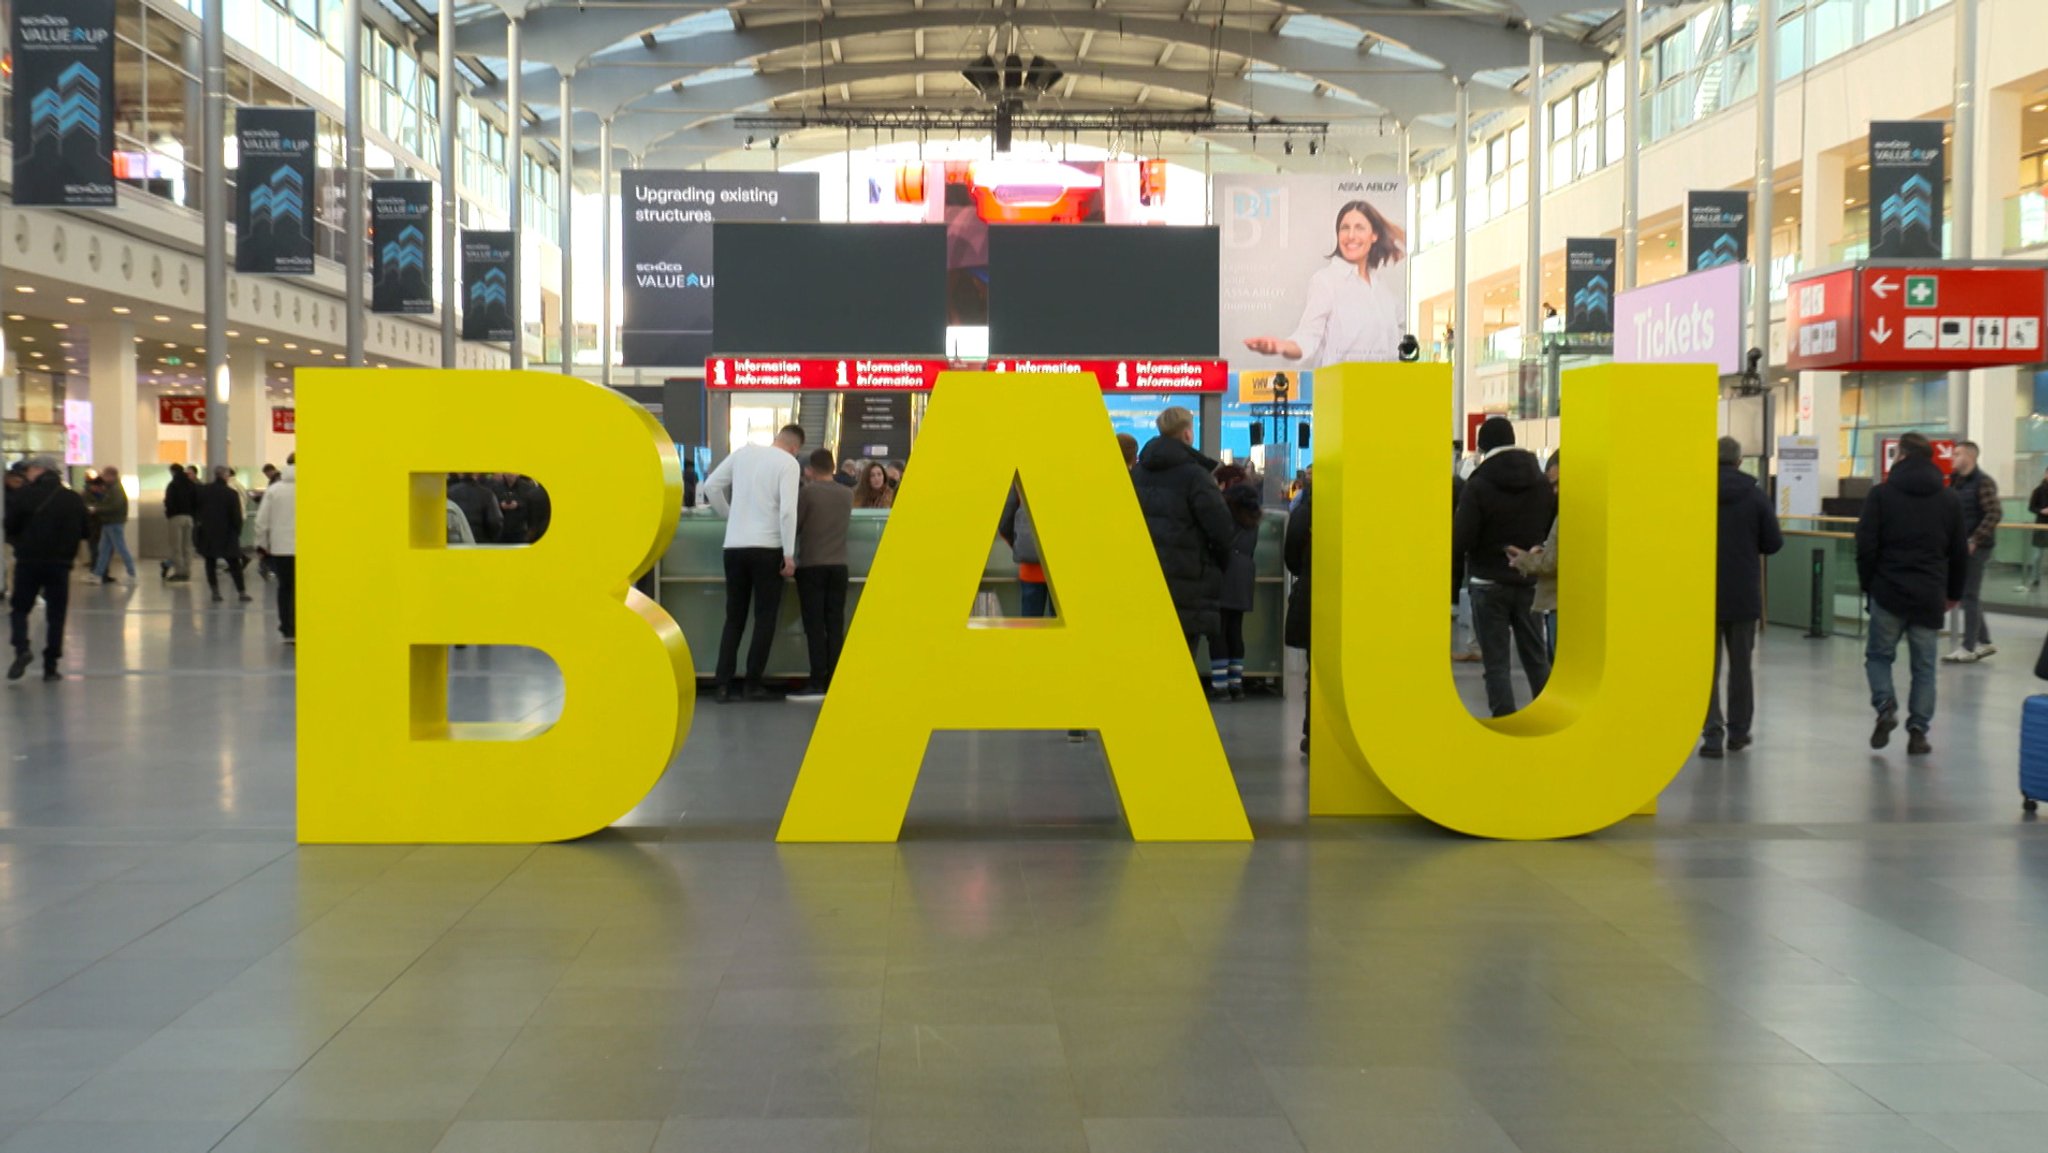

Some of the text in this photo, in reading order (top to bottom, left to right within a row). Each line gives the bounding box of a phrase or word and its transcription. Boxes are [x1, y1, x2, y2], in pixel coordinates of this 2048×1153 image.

[635, 185, 778, 207] Upgrading existing
[636, 274, 685, 288] VALUE
[1633, 301, 1715, 361] Tickets
[735, 359, 801, 372] Information
[856, 360, 923, 373] Information
[1136, 362, 1202, 374] Information
[735, 373, 801, 385] Information
[856, 374, 923, 386] Information
[1136, 375, 1203, 387] Information
[295, 362, 1718, 844] BAU
